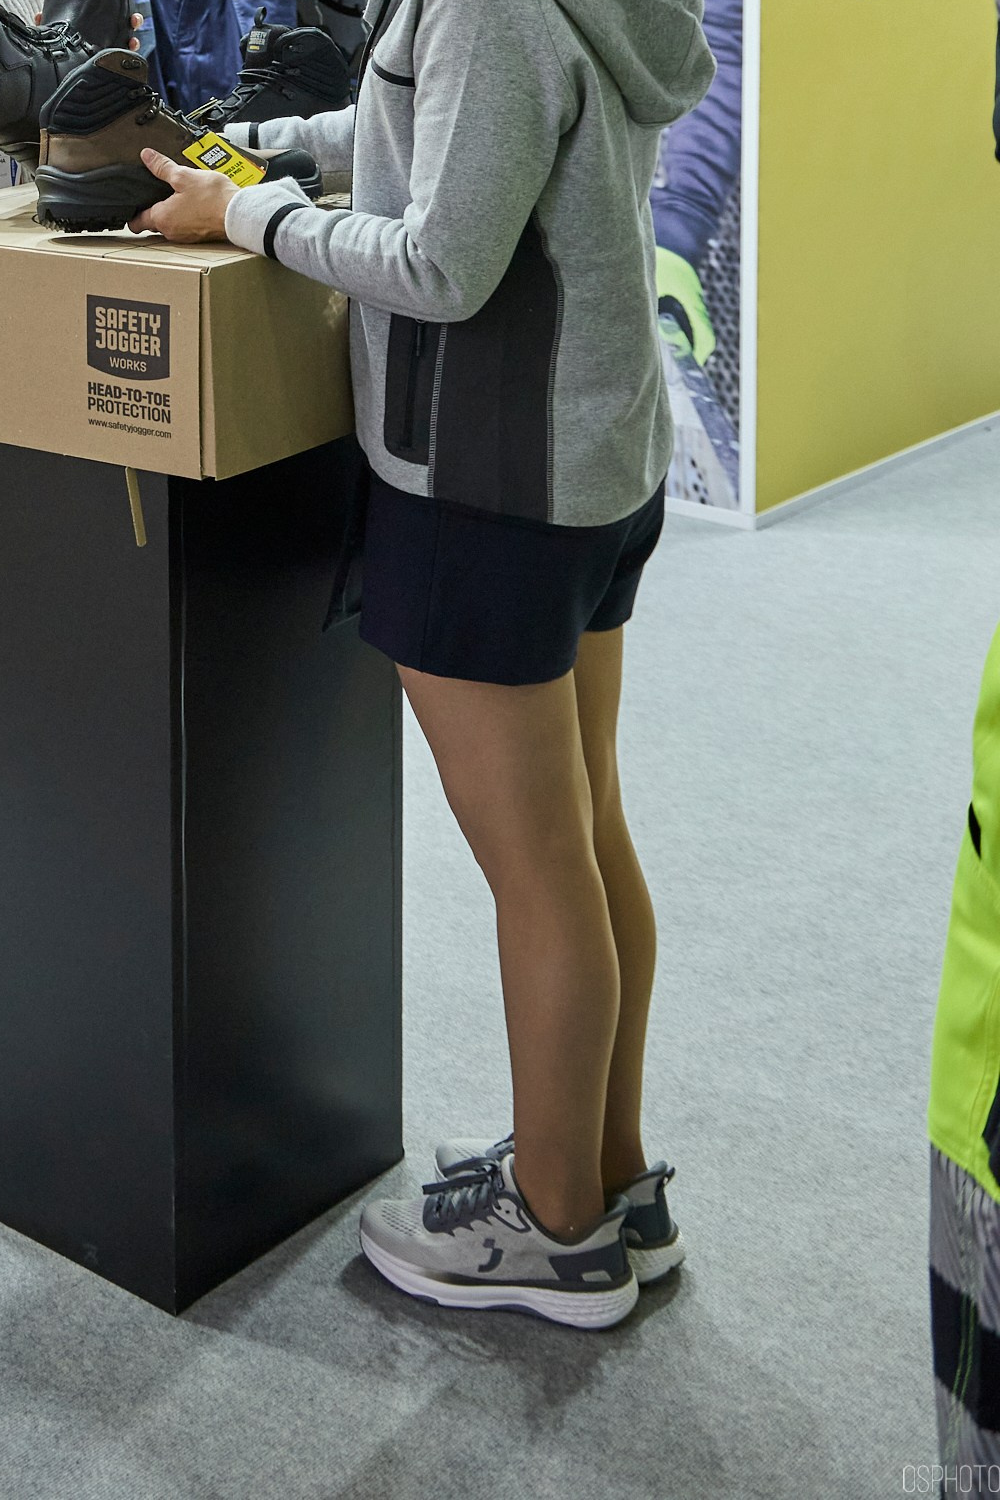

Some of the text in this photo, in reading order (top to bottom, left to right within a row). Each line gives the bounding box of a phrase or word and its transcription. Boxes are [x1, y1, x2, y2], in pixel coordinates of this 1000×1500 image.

[95, 306, 161, 334] SAFETY
[95, 329, 161, 357] JOGGER
[109, 356, 147, 373] WORKS
[87, 381, 171, 408] HEAD-TO-TOE
[87, 396, 171, 424] PROTECTION
[88, 417, 172, 439] www.safetyjogger.com
